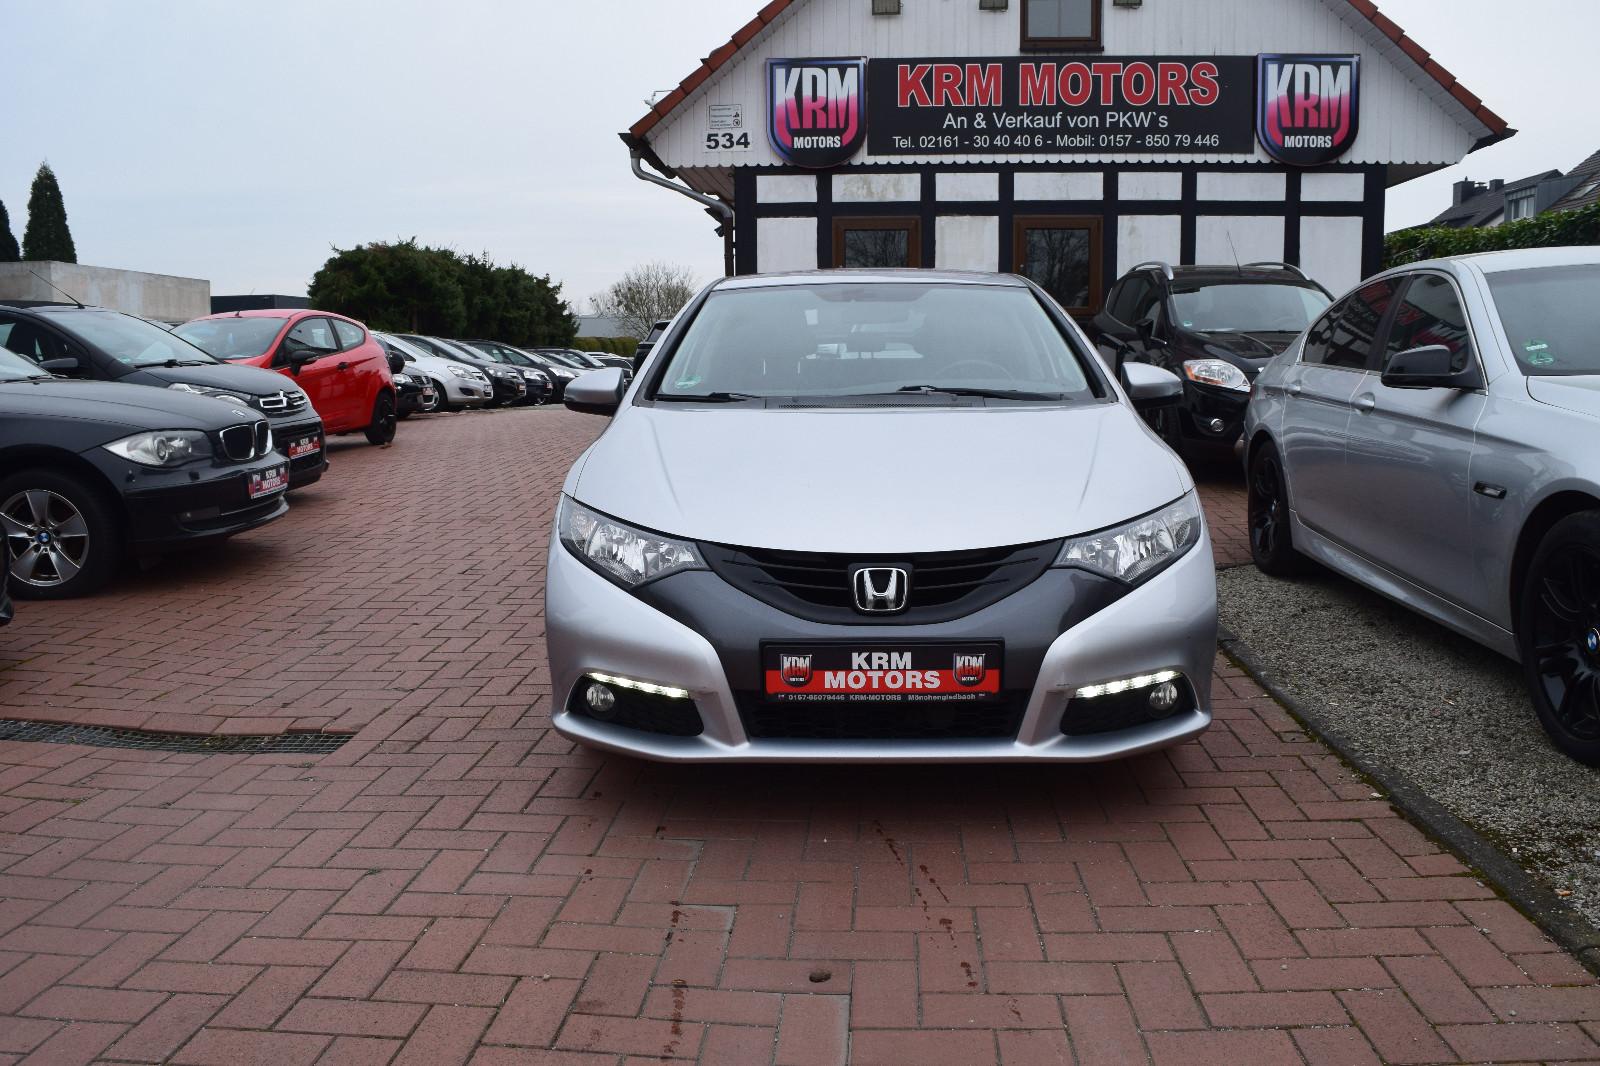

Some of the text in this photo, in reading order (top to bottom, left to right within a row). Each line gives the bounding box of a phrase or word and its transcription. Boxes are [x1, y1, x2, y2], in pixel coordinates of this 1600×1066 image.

[897, 61, 1220, 107] KRM MOTORS
[775, 68, 858, 147] KRM
[1267, 63, 1351, 147] KRM
[943, 113, 967, 128] An
[973, 112, 987, 129] &
[993, 111, 1062, 128] Verkauf
[1067, 115, 1099, 128] von
[705, 132, 750, 150] 534
[793, 136, 841, 148] MOTORS
[893, 136, 915, 148] Tel.
[919, 135, 959, 148] 02161
[973, 135, 990, 147] 30
[993, 134, 1010, 147] 40
[1013, 134, 1031, 147] 40
[1034, 134, 1043, 147] 6
[1056, 134, 1095, 147] Mobil:
[1099, 134, 1132, 147] 0157
[1145, 134, 1170, 147] 850
[1174, 134, 1191, 147] 79
[1194, 133, 1220, 147] 446
[1284, 135, 1333, 148] MOTORS
[851, 651, 912, 670] KRM
[824, 670, 941, 689] MOTORS
